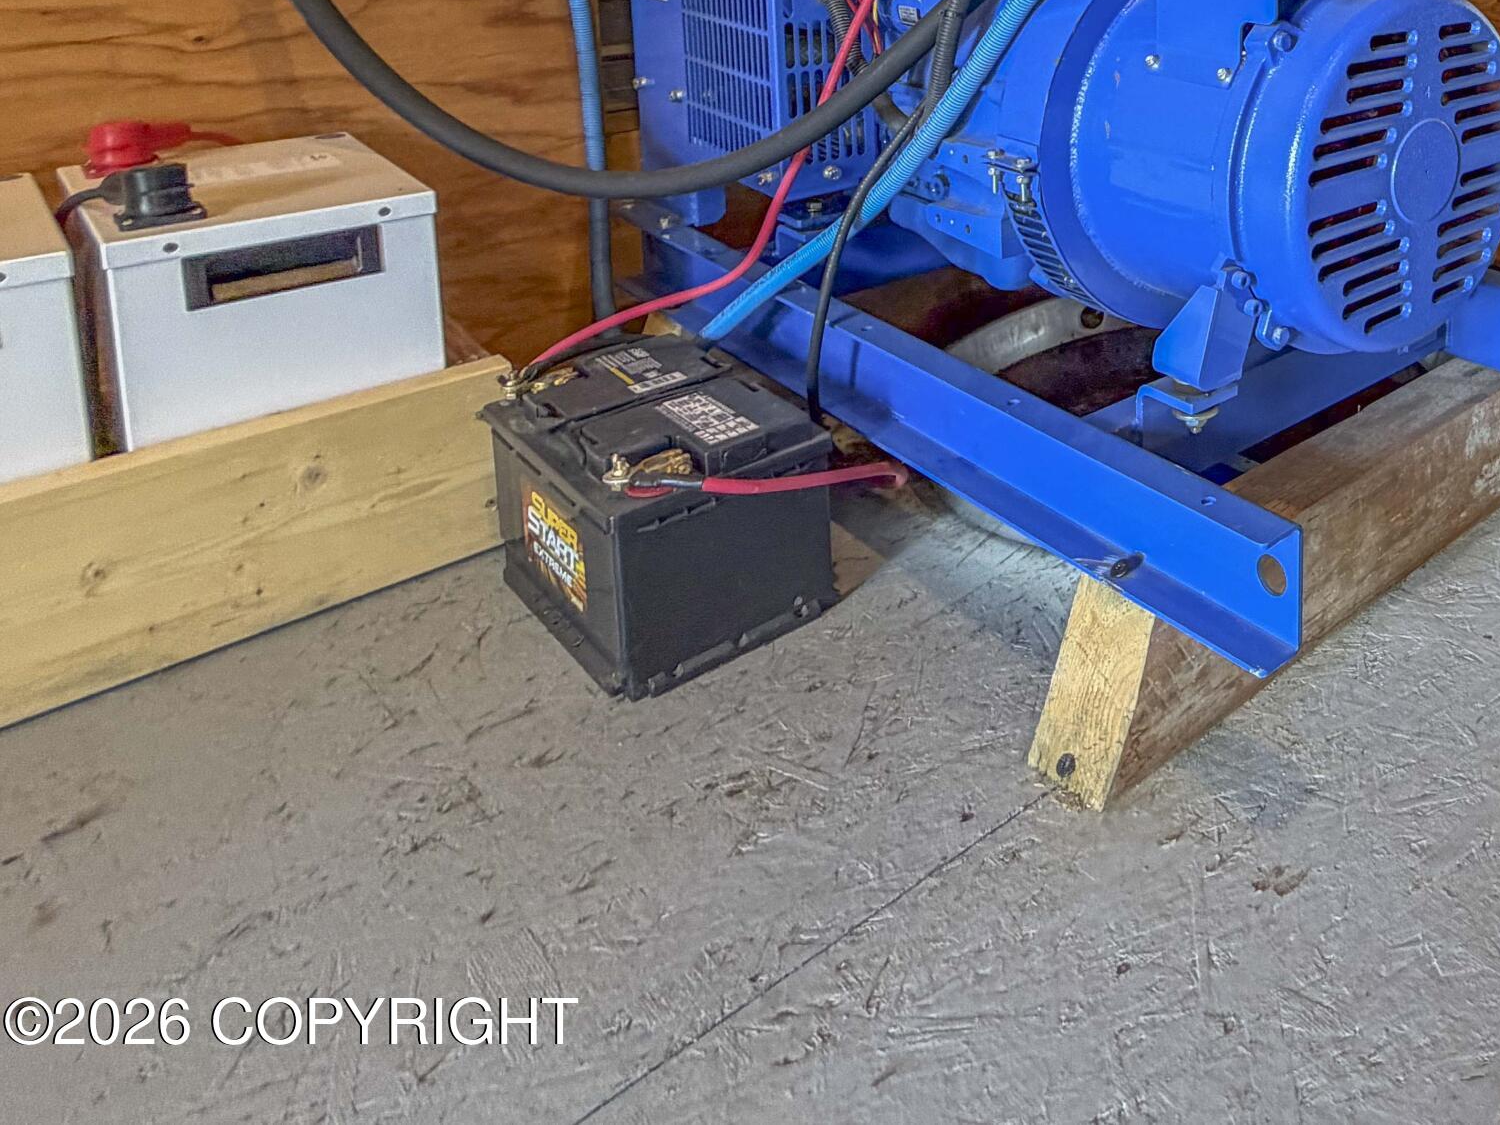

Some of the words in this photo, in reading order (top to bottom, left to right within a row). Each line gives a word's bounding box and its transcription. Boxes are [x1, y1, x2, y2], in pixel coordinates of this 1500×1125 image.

[527, 505, 579, 576] START
[531, 491, 577, 550] SUPER
[533, 540, 573, 588] EXTREME
